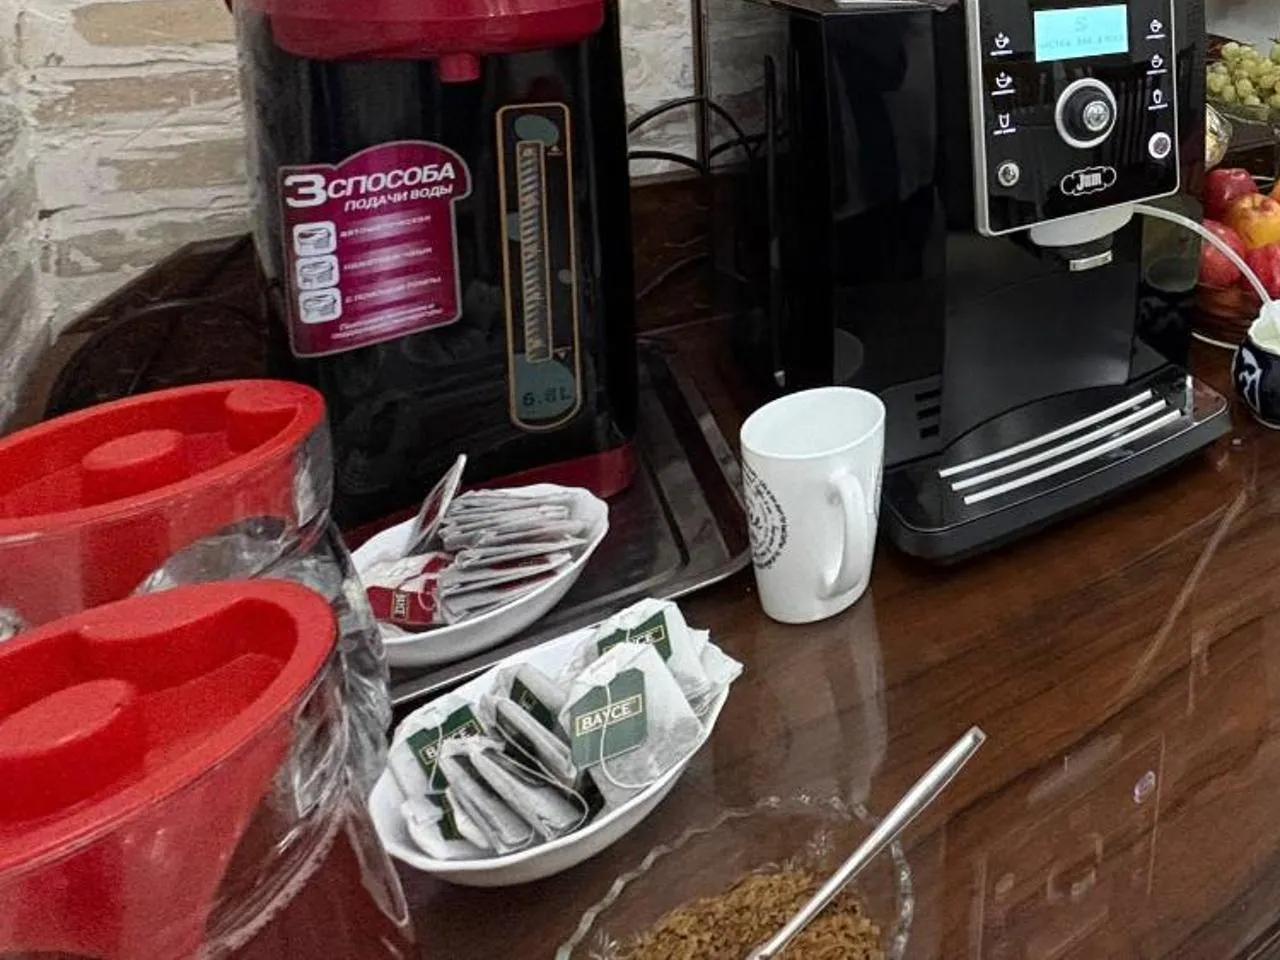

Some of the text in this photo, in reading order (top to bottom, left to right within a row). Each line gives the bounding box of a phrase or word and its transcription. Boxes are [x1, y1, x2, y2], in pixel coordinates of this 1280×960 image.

[284, 162, 456, 208] 3 СПОСОБА
[344, 184, 453, 212] ПОДАЧИ ВОДЫ
[582, 701, 632, 730] BAYCE
